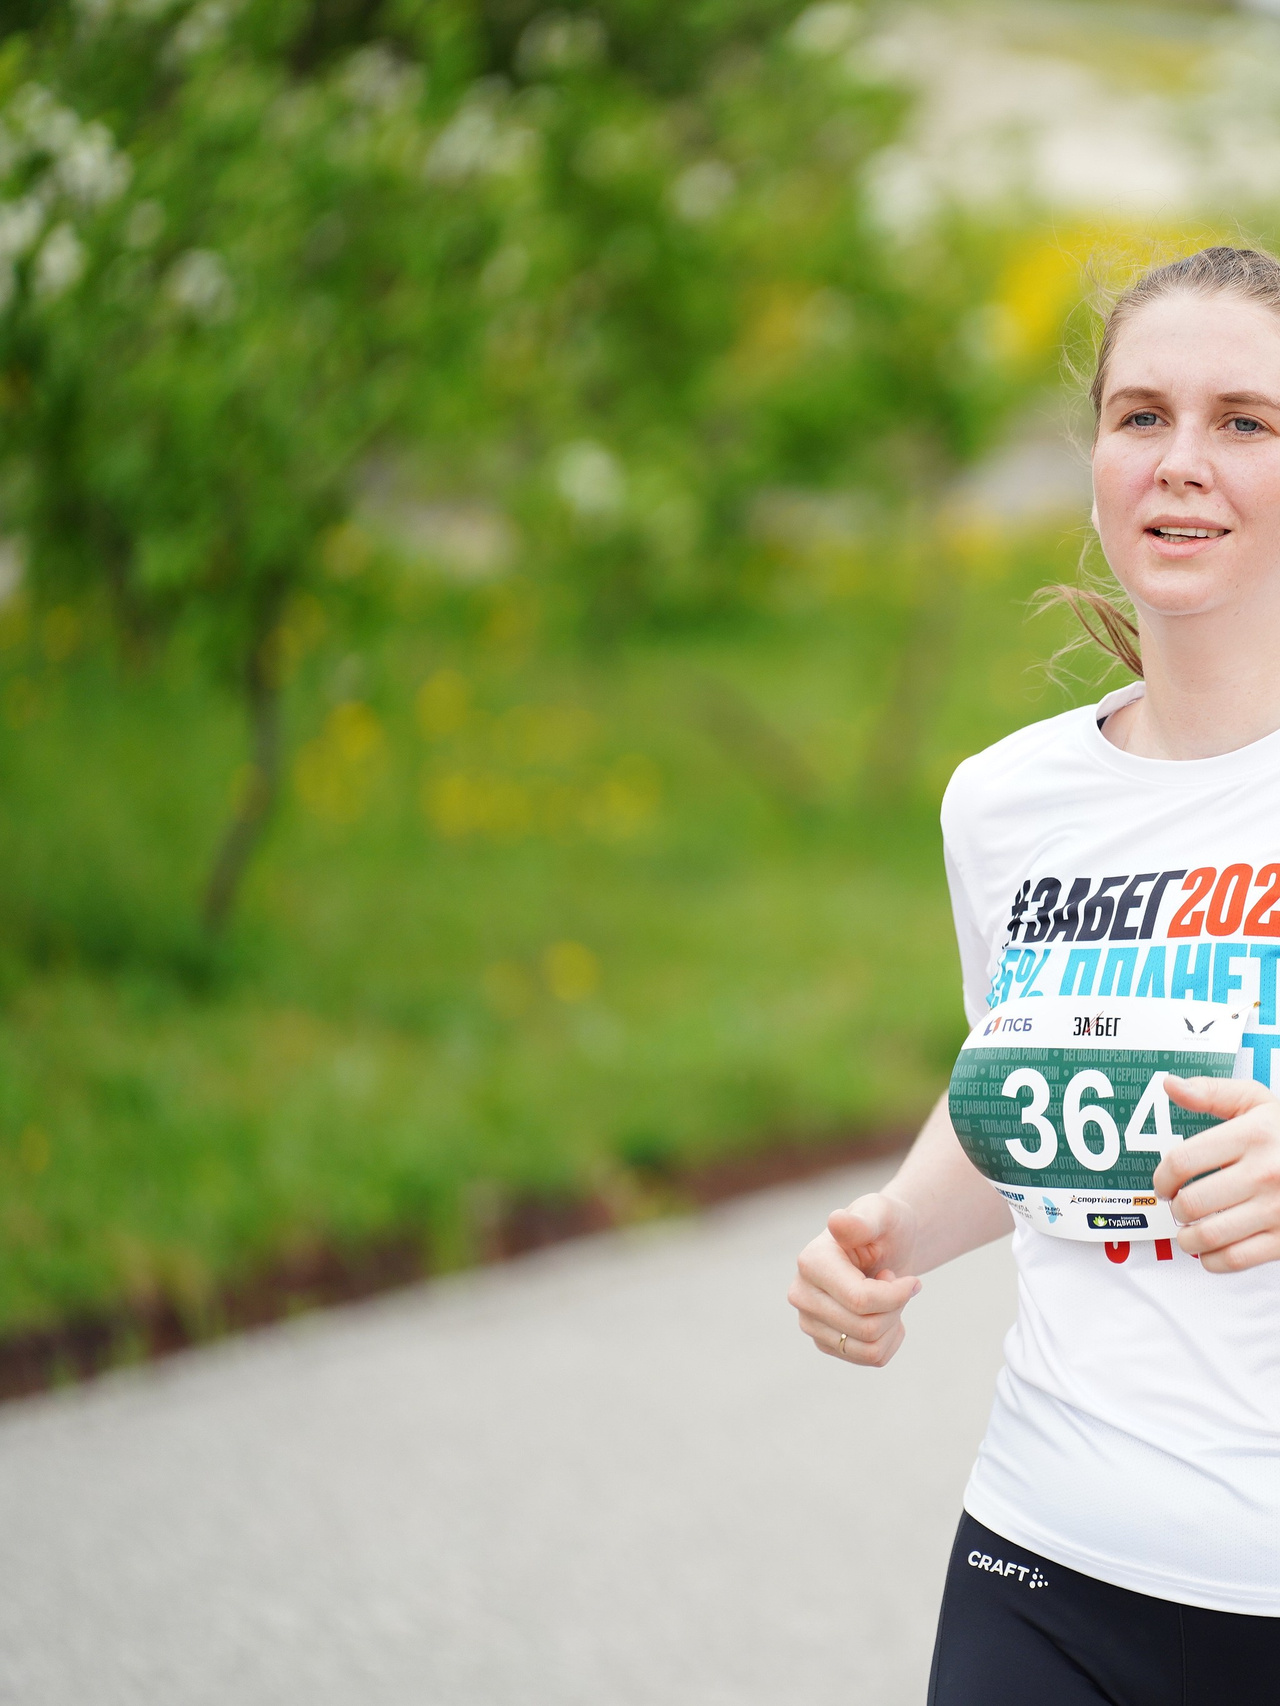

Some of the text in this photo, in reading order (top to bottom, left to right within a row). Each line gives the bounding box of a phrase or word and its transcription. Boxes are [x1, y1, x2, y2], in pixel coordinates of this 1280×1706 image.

[1002, 1018, 1033, 1032] ПСБ
[963, 1100, 989, 1116] ДАВНО
[991, 1101, 1020, 1116] ОТСТАЛ
[1001, 1066, 1185, 1172] 364
[1134, 1197, 1156, 1205] PRO
[967, 1550, 1030, 1582] CRAFT
